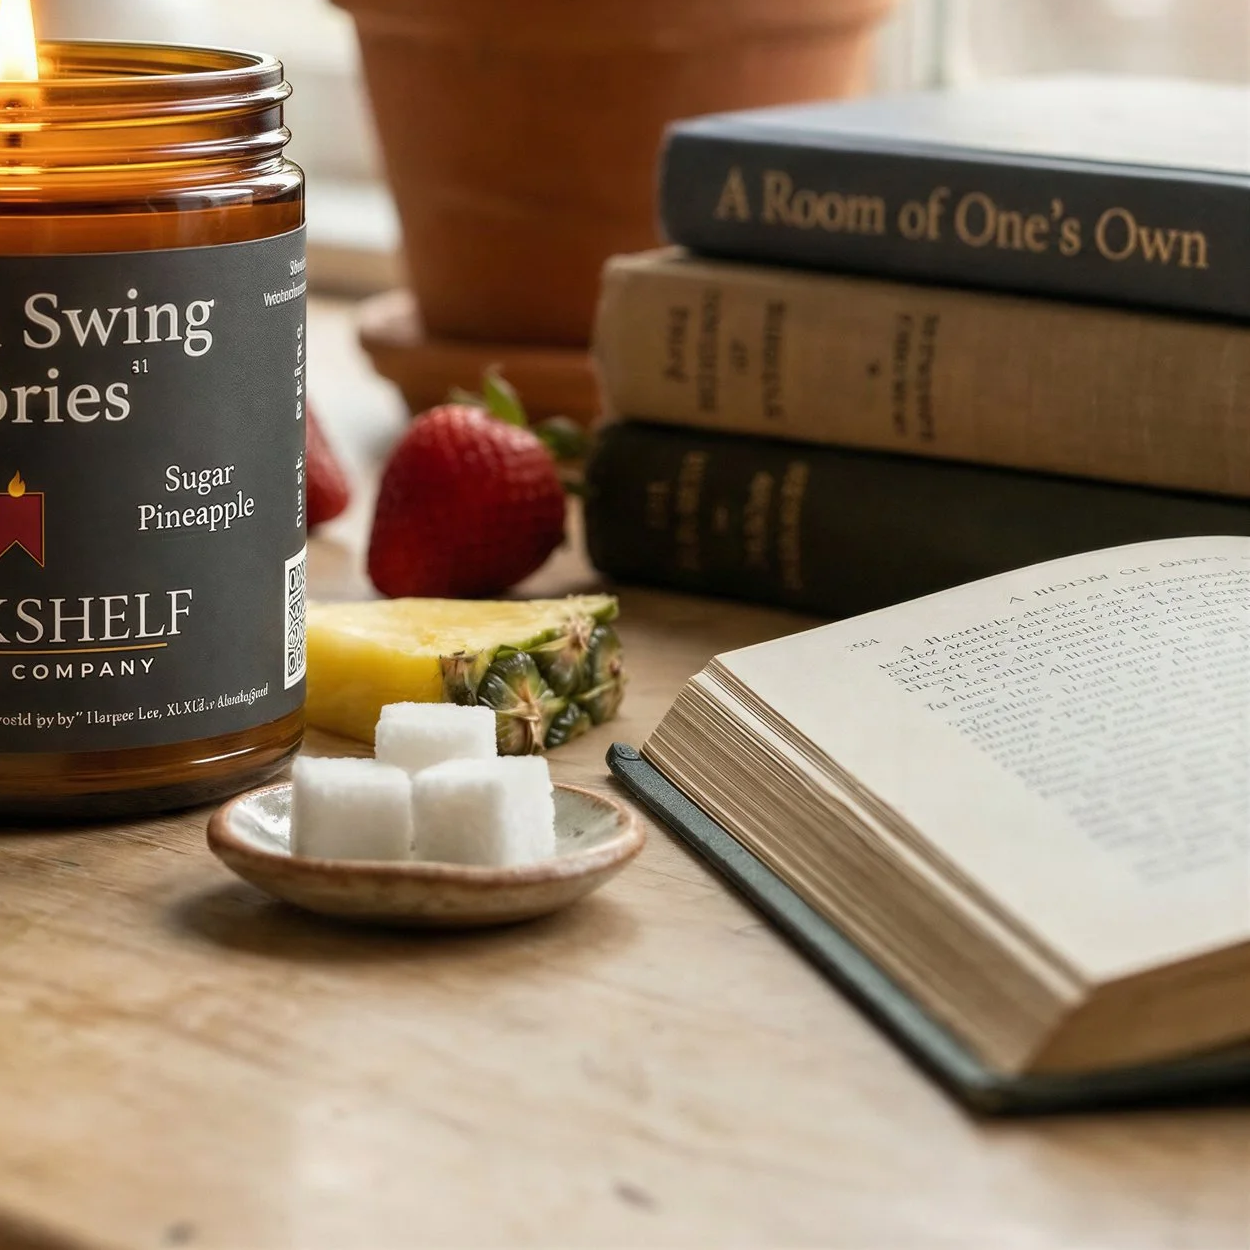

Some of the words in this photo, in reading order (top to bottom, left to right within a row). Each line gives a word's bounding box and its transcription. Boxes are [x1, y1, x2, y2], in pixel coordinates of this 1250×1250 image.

[715, 166, 748, 221] A
[762, 170, 886, 235] Room
[898, 187, 948, 241] of
[955, 191, 1081, 256] One's
[1095, 207, 1209, 269] Own
[23, 288, 215, 357] Swing
[165, 464, 235, 495] Sugar
[137, 490, 255, 532] Pineapple
[11, 657, 155, 681] COMPANY
